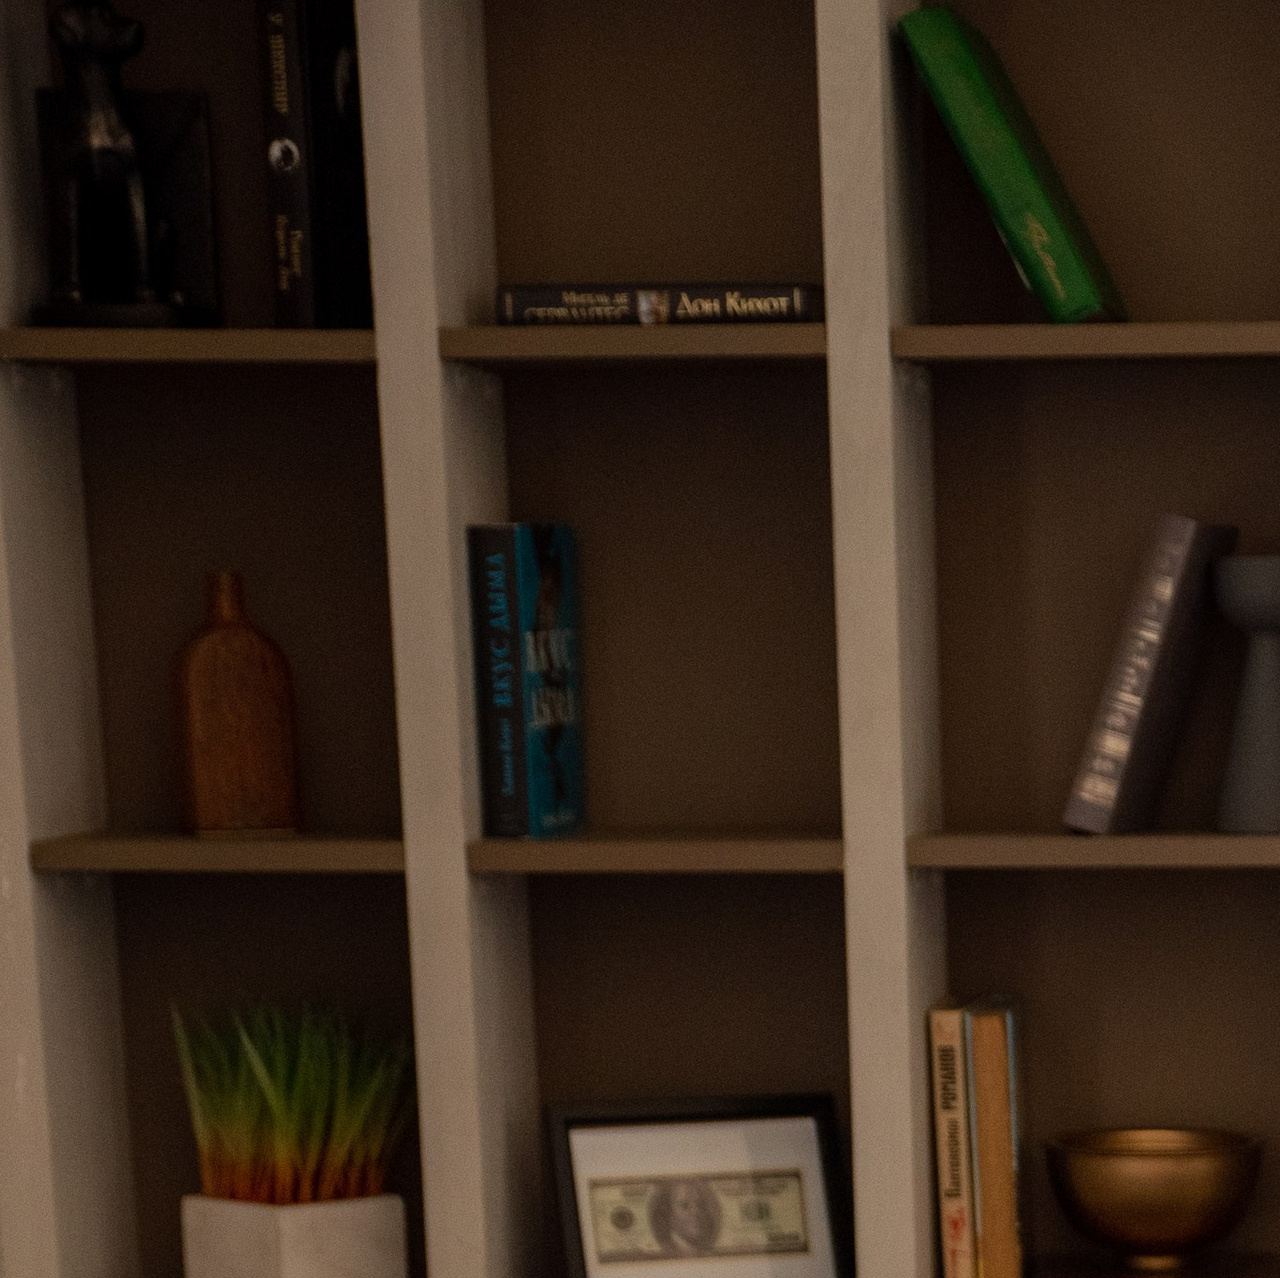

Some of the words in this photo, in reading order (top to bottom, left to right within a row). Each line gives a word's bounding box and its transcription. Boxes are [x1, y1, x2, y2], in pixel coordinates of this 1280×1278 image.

[675, 292, 721, 317] Дон
[725, 290, 790, 316] Кихот
[484, 553, 510, 630] ДЫМА
[490, 638, 514, 707] ВКУС
[939, 1045, 958, 1111] РОМАНОВ
